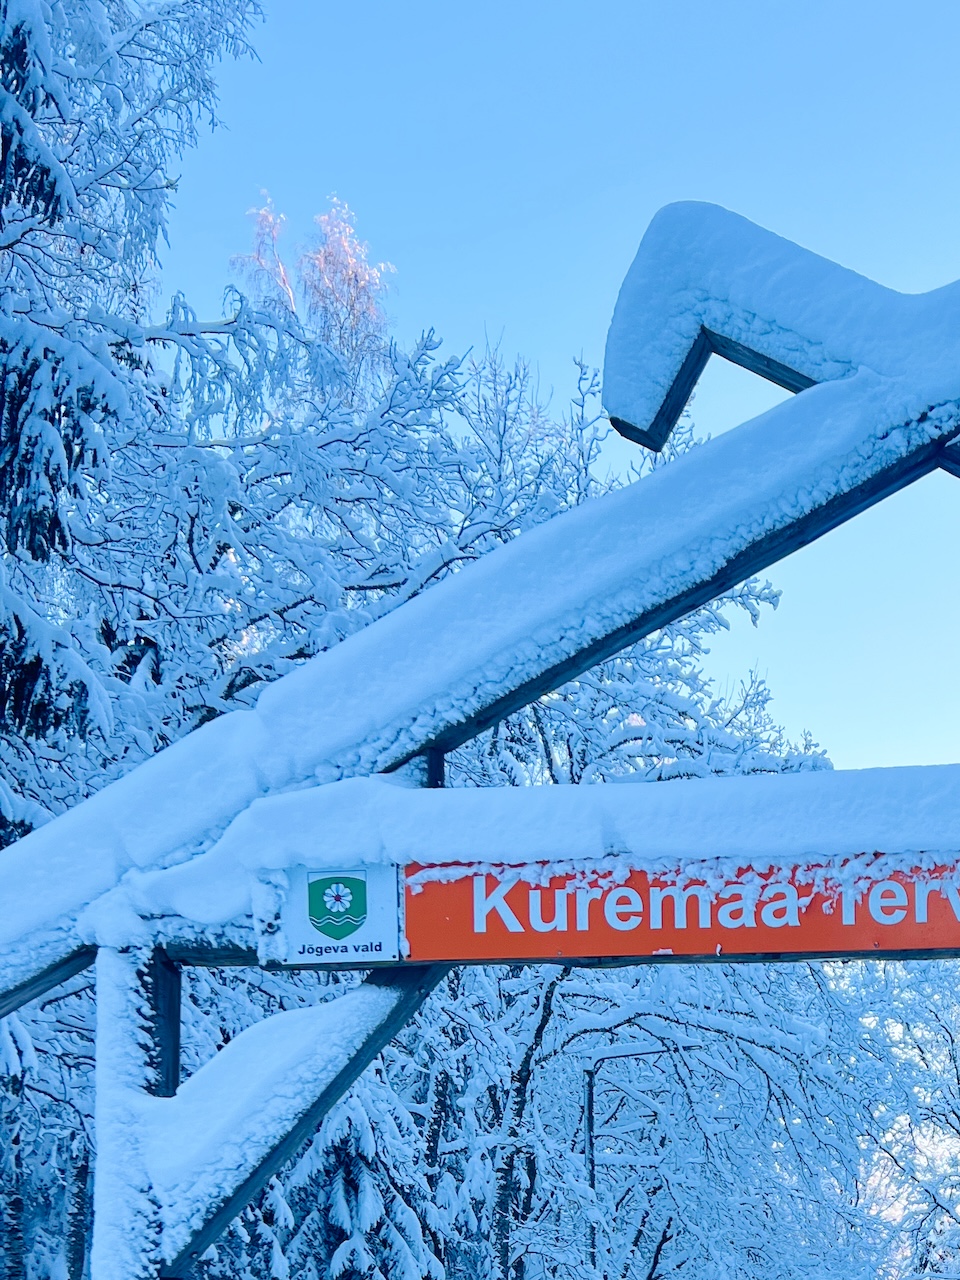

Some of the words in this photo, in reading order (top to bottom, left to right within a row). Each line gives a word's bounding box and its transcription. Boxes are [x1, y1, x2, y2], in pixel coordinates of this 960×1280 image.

[472, 874, 801, 934] Kuremaa
[298, 943, 349, 957] Jõgeva
[353, 941, 383, 953] vald
